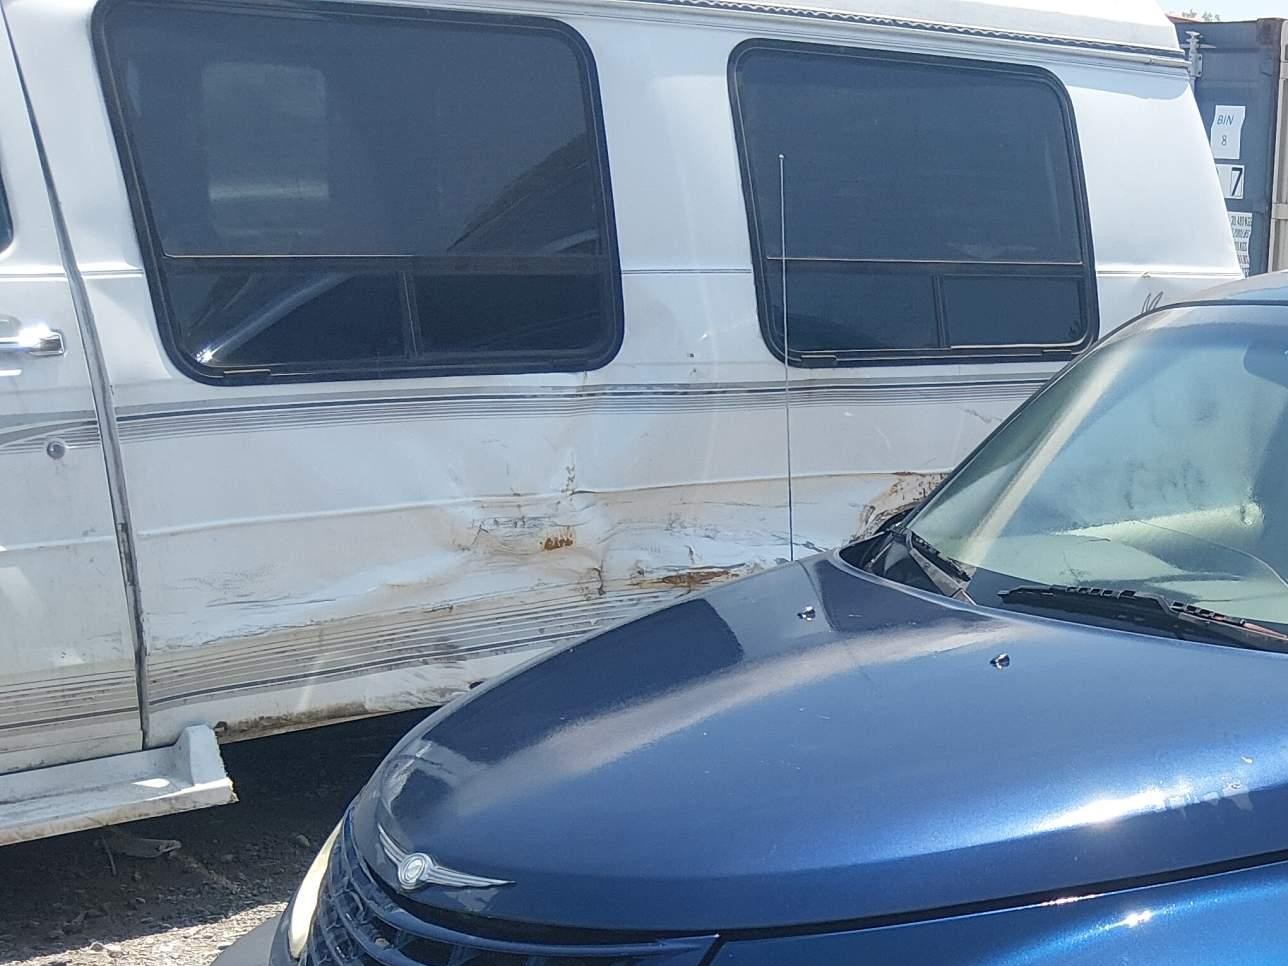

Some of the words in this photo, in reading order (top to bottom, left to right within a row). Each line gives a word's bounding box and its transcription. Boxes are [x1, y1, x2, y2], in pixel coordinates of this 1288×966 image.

[1217, 115, 1234, 126] BIN
[1221, 135, 1228, 146] 8
[1230, 167, 1243, 197] 7
